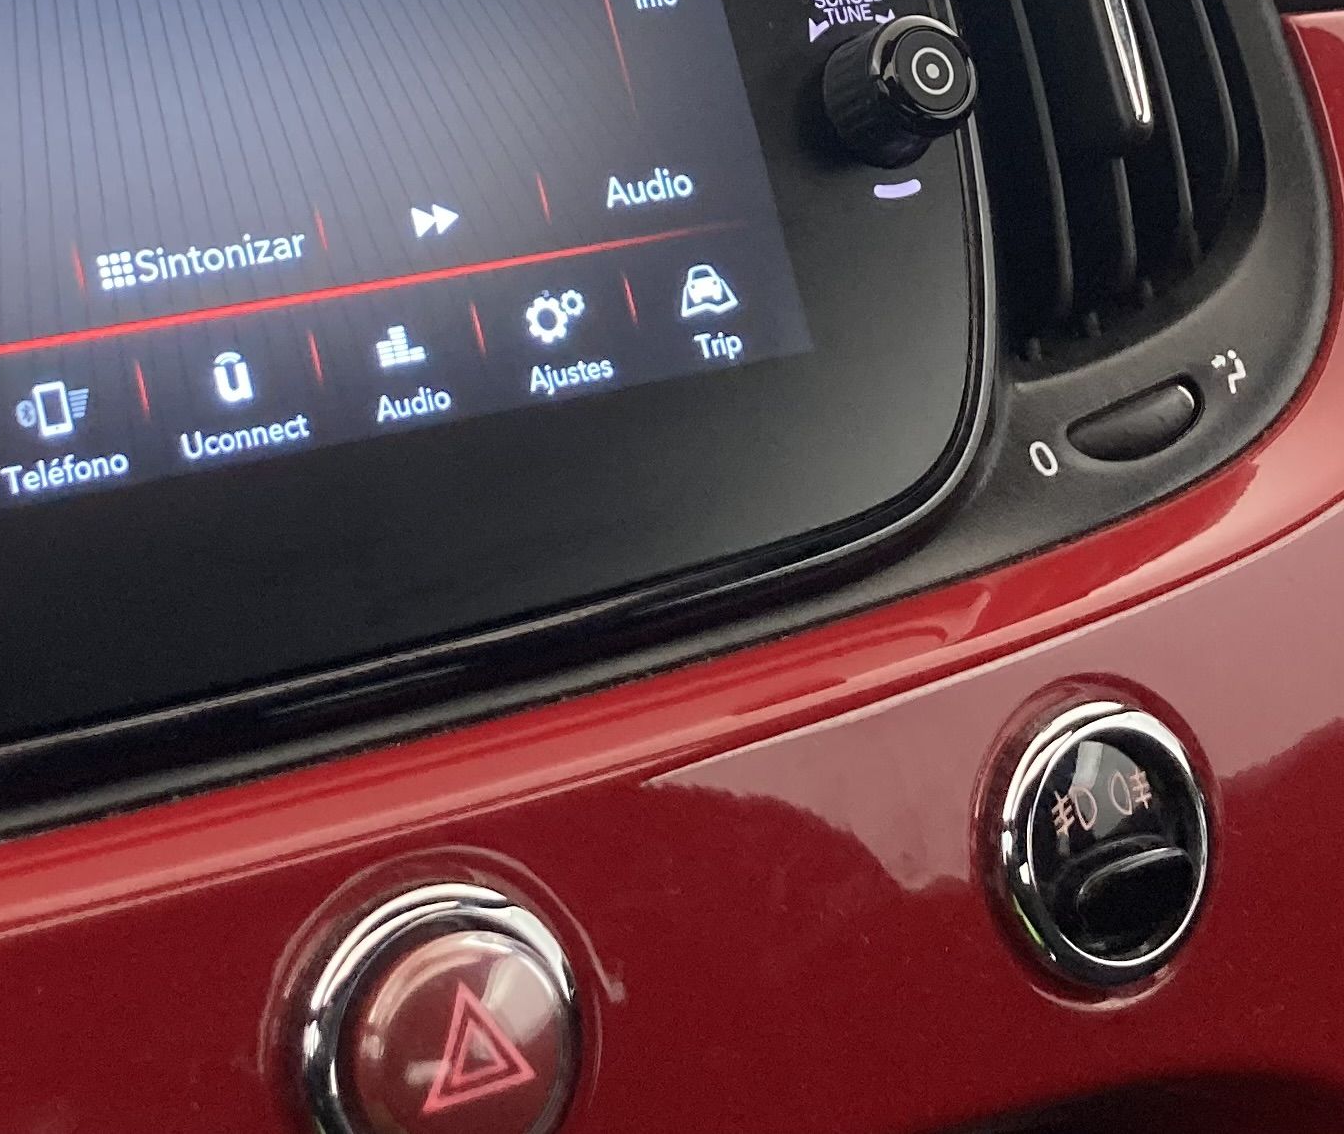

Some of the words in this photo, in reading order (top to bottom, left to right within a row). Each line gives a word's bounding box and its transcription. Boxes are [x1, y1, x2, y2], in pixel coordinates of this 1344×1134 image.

[824, 4, 873, 23] TUNE
[607, 167, 694, 210] Audio
[135, 231, 306, 283] Sintonizar
[694, 333, 743, 362] Trip
[529, 356, 614, 395] Ajustes
[377, 385, 452, 422] Audio
[181, 413, 310, 461] Uconnect
[0, 450, 130, 495] Teléfono
